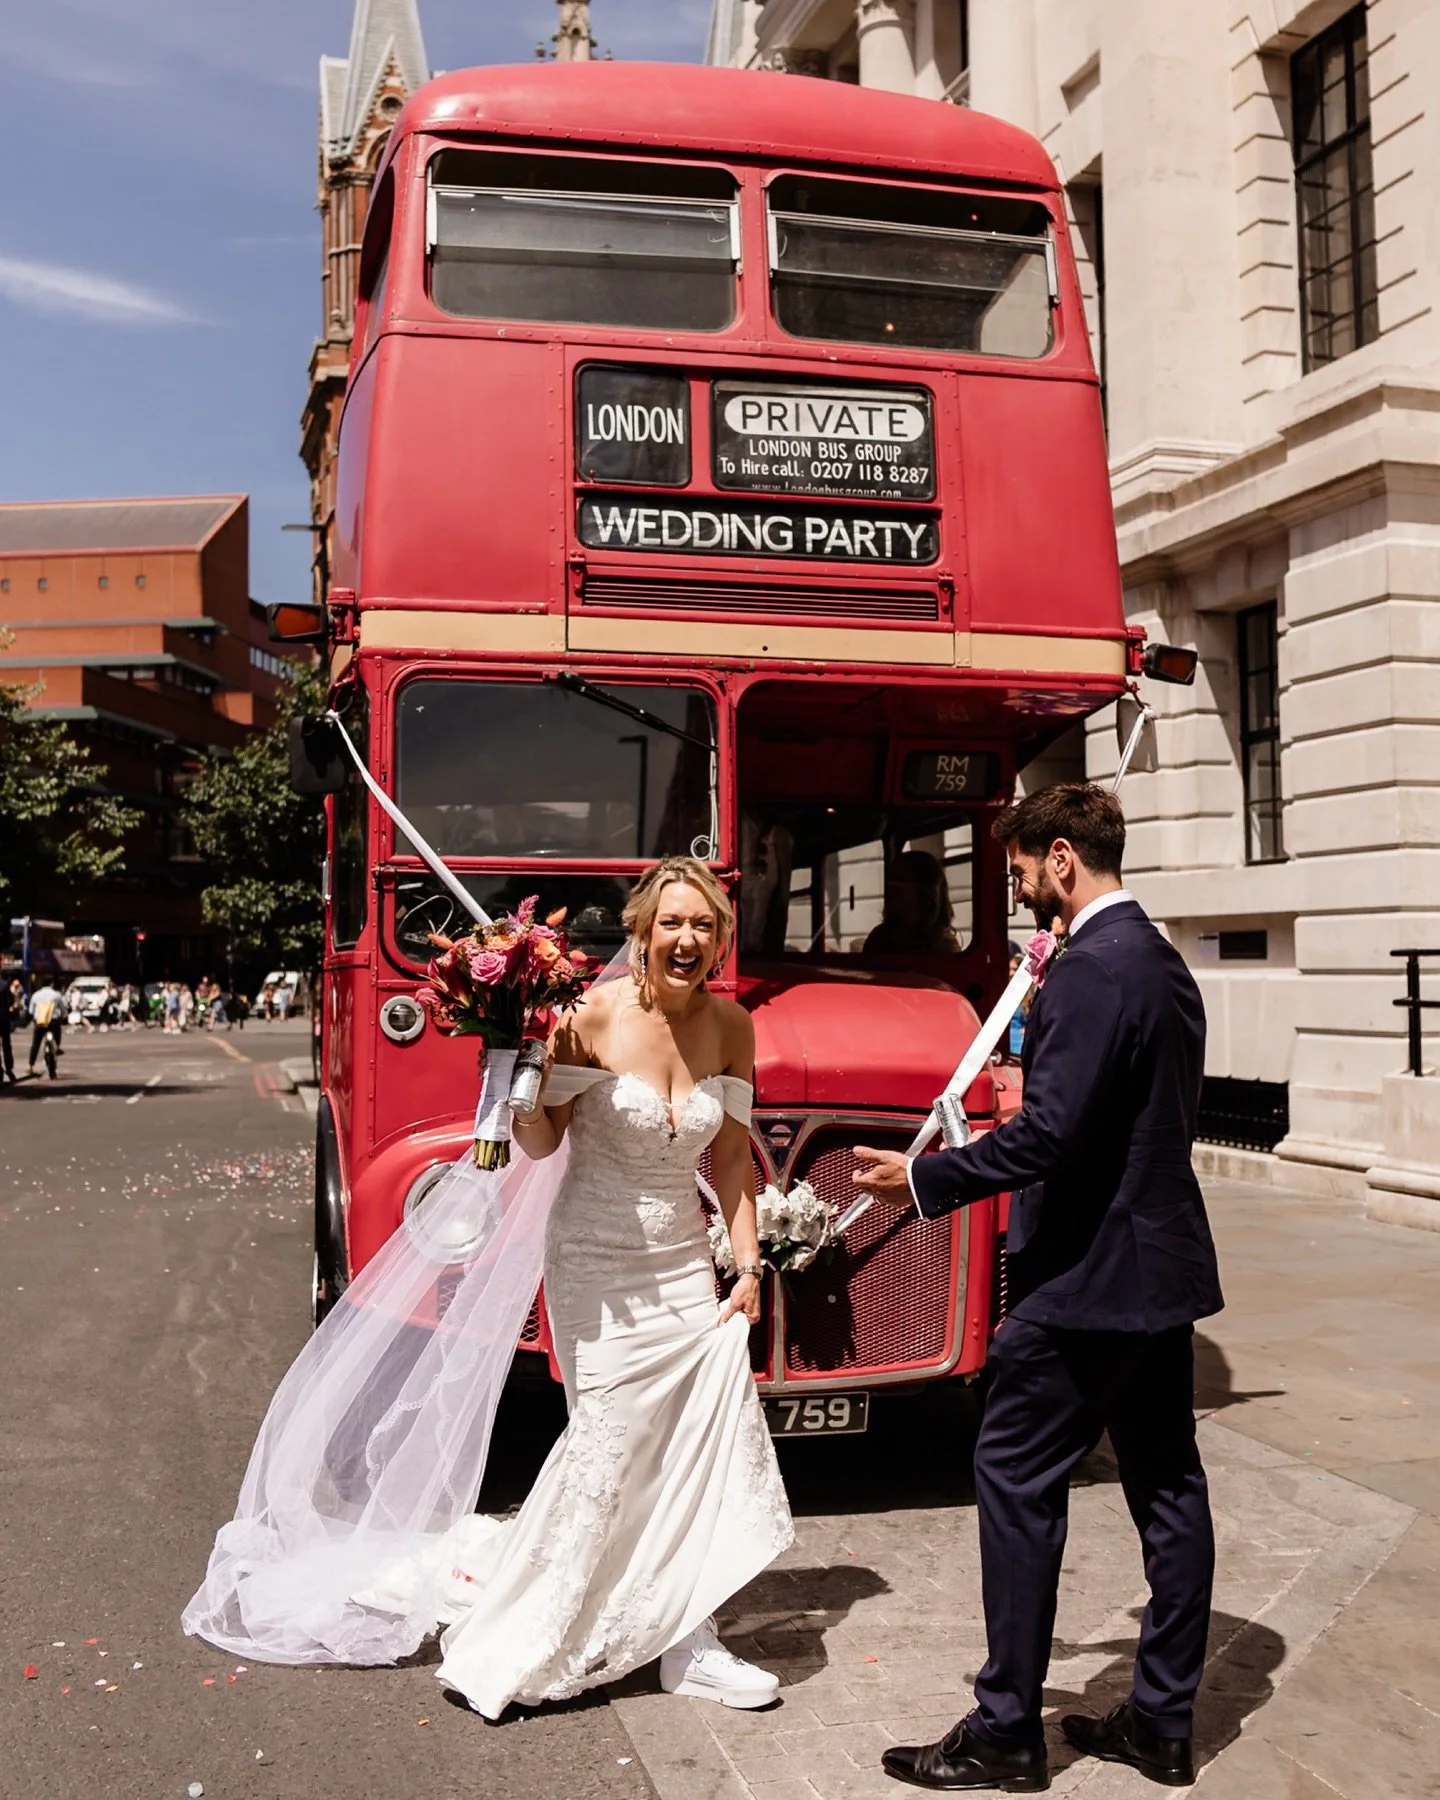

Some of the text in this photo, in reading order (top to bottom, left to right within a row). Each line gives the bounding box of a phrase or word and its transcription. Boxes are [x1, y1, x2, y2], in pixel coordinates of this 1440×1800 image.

[588, 403, 685, 445] LONDON
[741, 400, 909, 438] PRIVATE
[749, 439, 902, 462] LONDON BUS GROUP
[720, 457, 735, 474] To
[741, 459, 769, 475] Hire
[810, 461, 853, 479] 0207
[859, 464, 884, 481] 118
[889, 466, 929, 484] 8287
[591, 505, 927, 559] WEDDING PARTY
[937, 755, 970, 773] RM
[934, 774, 967, 792] 759
[777, 1397, 851, 1431] 759
